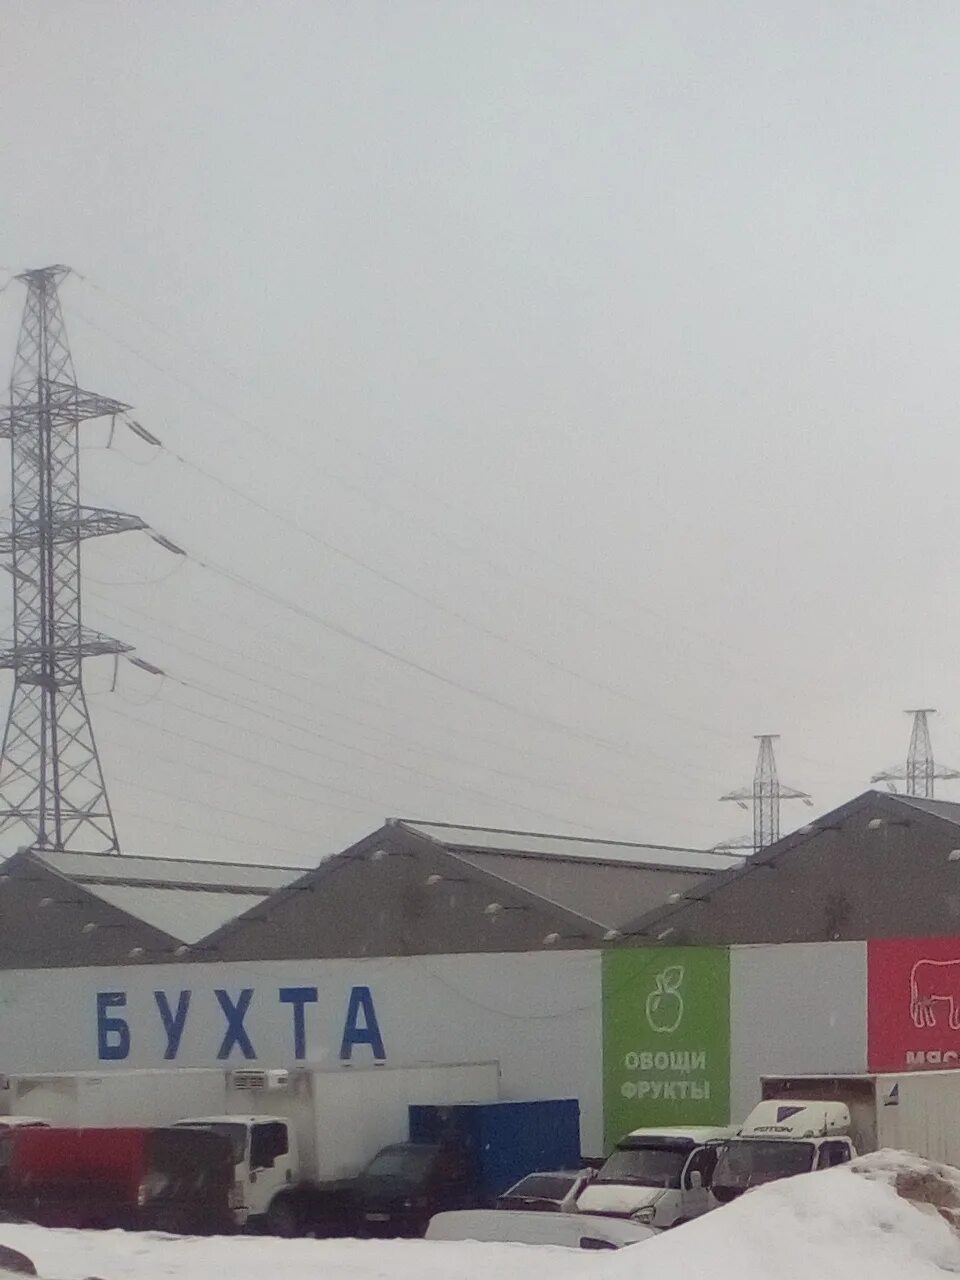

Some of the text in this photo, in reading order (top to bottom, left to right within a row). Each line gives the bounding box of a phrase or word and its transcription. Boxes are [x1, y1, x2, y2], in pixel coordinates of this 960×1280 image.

[97, 986, 386, 1060] БУХТА
[624, 1051, 706, 1073] ОВОЩИ
[620, 1080, 711, 1099] ФРУКТЫ
